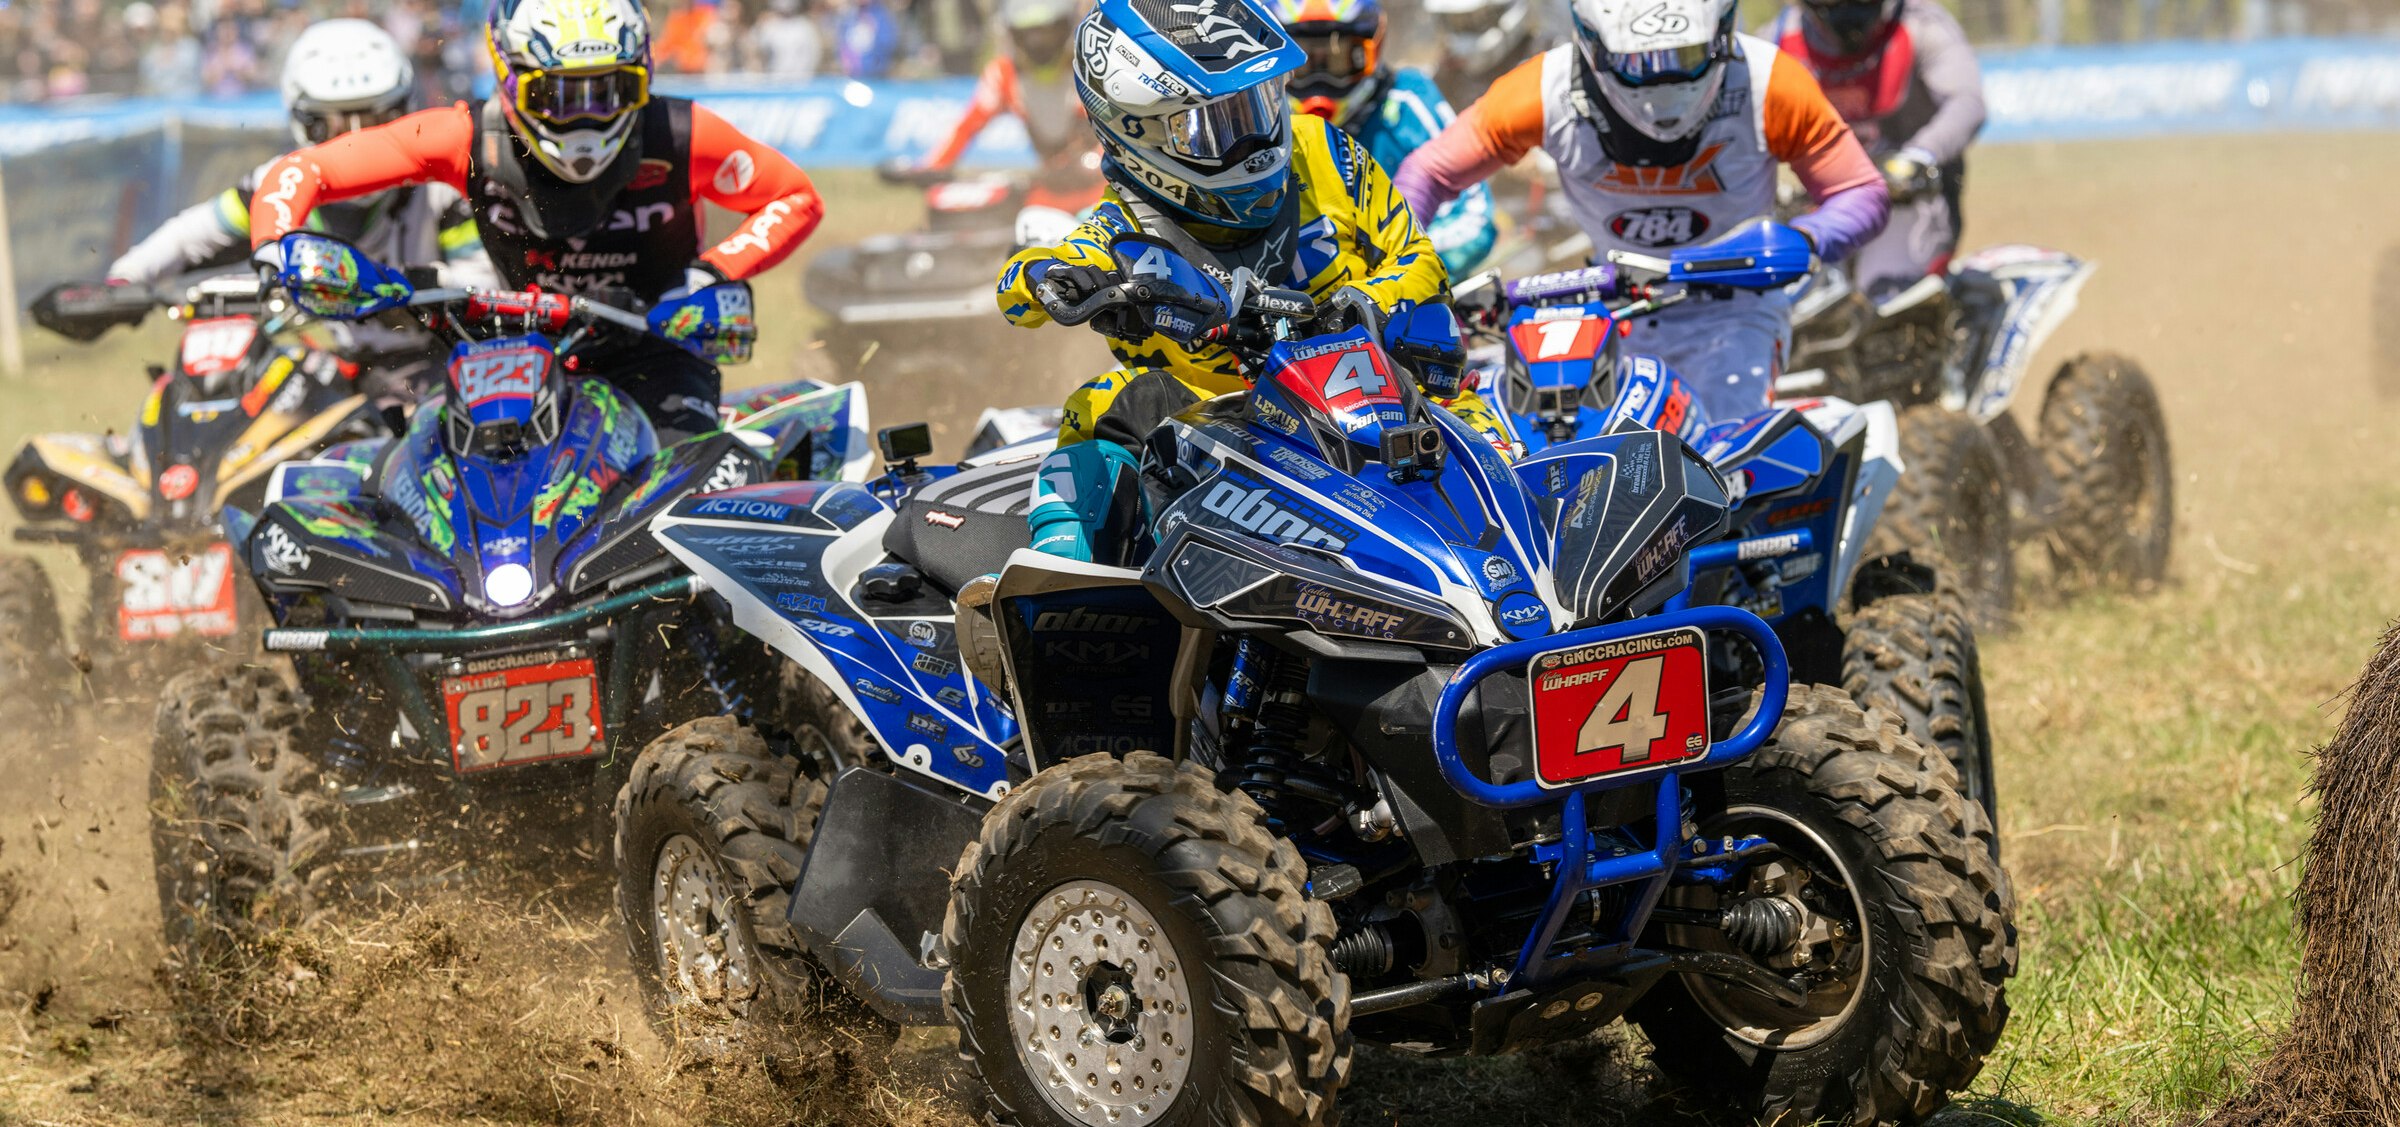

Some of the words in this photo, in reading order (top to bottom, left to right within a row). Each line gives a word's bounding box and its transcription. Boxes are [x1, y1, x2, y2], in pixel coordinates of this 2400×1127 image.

[1115, 44, 1141, 67] ACTION
[1138, 73, 1172, 97] RACE
[1158, 72, 1187, 96] PRO
[1126, 157, 1186, 202] 204
[1621, 211, 1693, 244] 784
[559, 251, 638, 270] KENDA
[1132, 246, 1172, 281] 4
[1257, 293, 1303, 312] flexx
[1155, 313, 1197, 336] WHARFF
[1293, 337, 1367, 361] WHARFF
[1537, 320, 1583, 359] 1
[459, 352, 545, 405] 823
[1322, 349, 1388, 401] 4
[1254, 394, 1301, 431] LEMUS
[1257, 412, 1298, 436] Racing
[1269, 446, 1333, 480] TRACKSIDE
[697, 500, 779, 519] ACTION
[1331, 491, 1362, 513] Powersports
[1341, 488, 1379, 513] Performance
[1570, 468, 1596, 529] AXIS
[1487, 562, 1513, 578] SM
[1296, 581, 1332, 599] Kaden
[1294, 593, 1405, 632] WHARFF
[1296, 609, 1396, 640] RACING
[912, 624, 932, 640] SM
[1562, 633, 1694, 666] GNCCRACING.COM
[1542, 668, 1610, 692] WHARFF
[459, 676, 593, 769] 823
[1574, 655, 1669, 765] 4
